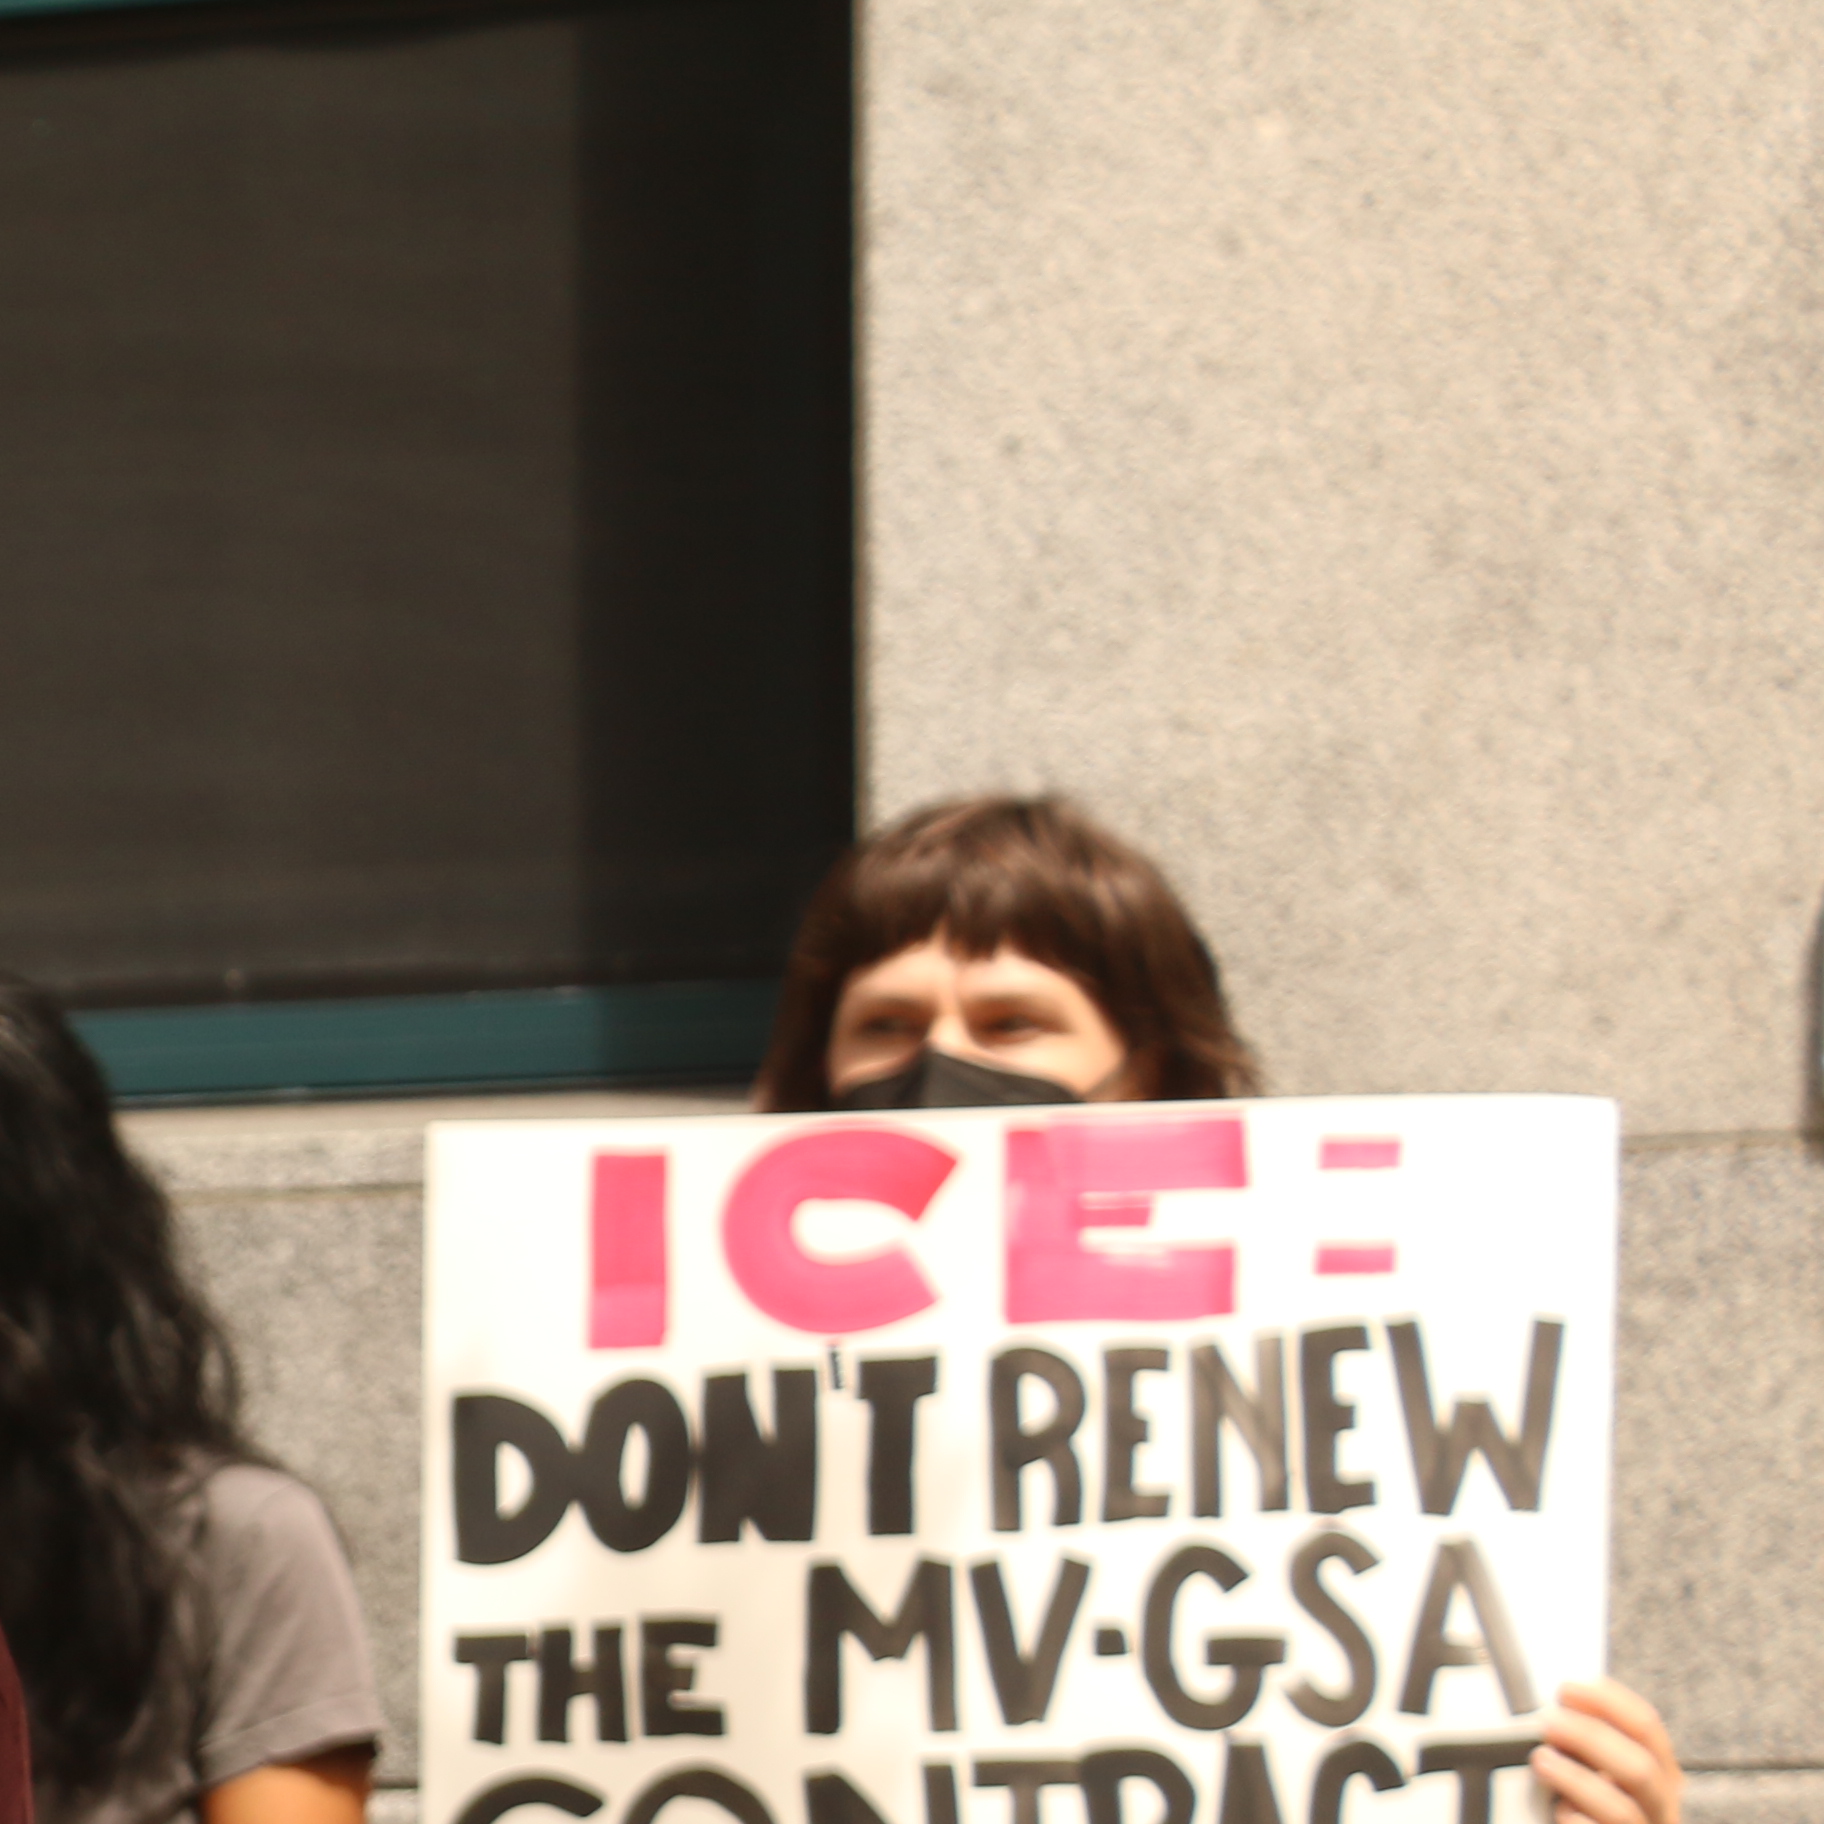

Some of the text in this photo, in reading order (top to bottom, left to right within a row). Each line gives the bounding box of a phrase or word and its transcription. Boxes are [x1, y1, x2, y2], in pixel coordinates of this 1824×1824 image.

[587, 1112, 1401, 1349] ICE:
[451, 1320, 1564, 1565] DON'T RENEW
[454, 1532, 1538, 1745] THE MV-GSA
